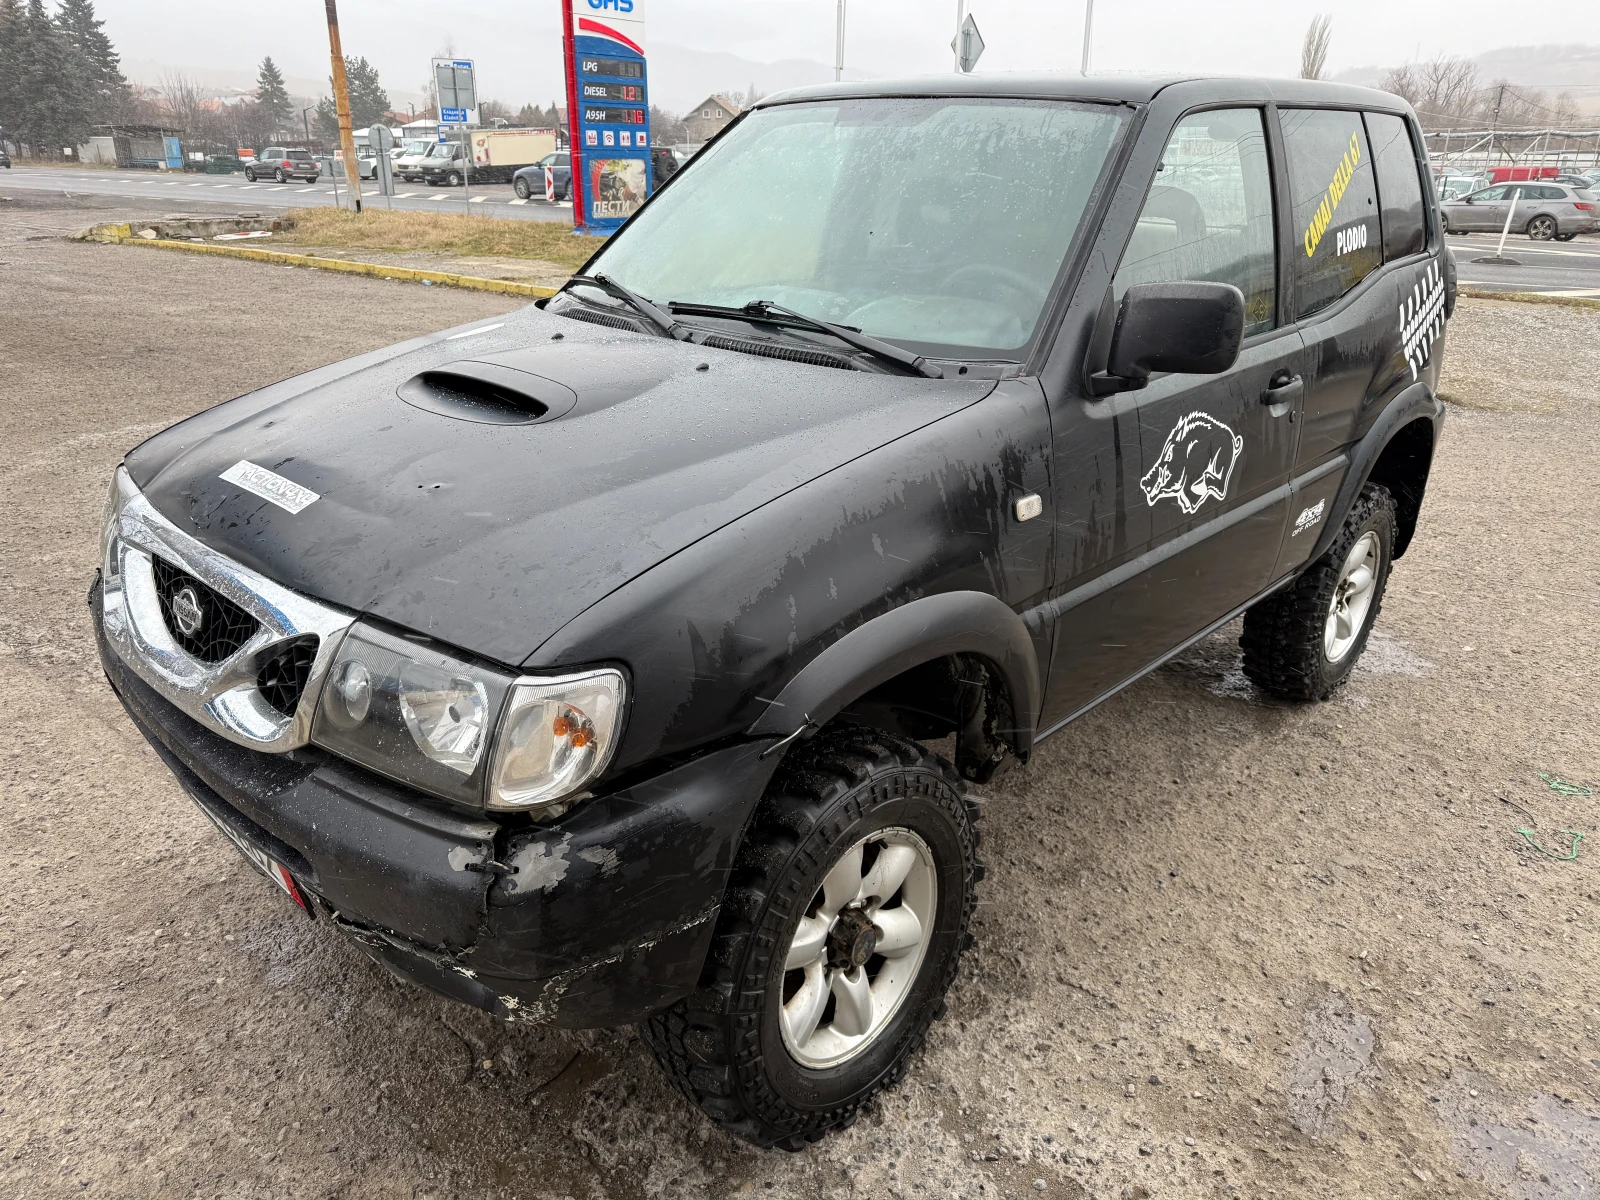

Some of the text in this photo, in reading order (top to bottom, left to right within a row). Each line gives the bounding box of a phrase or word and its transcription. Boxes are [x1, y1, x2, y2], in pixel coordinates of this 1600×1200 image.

[583, 61, 598, 72] LPG
[584, 86, 607, 97] DIESEL
[585, 110, 606, 121] A95H
[1329, 152, 1354, 211] DELLA
[1349, 131, 1361, 166] 67
[593, 200, 630, 213] ПЕСТИ
[1336, 224, 1367, 256] PLODIO
[1292, 515, 1322, 537] OFF ROAD
